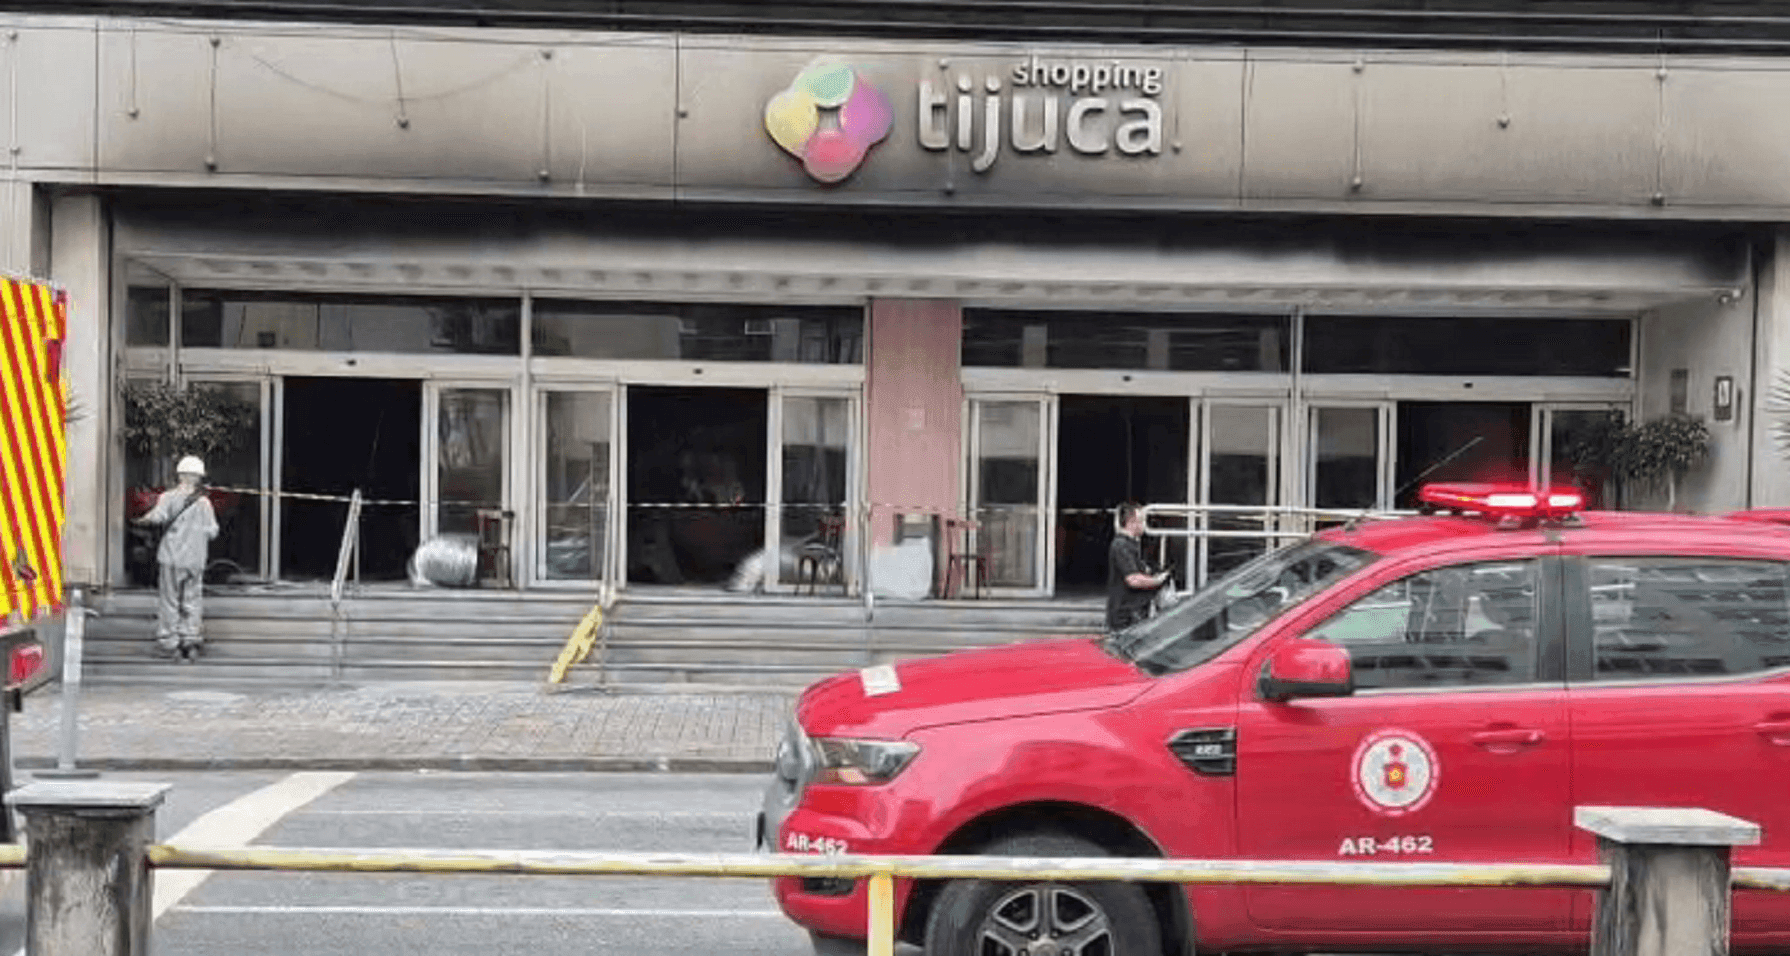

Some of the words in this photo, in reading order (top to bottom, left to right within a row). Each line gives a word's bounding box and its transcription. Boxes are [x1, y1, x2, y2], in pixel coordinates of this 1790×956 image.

[1012, 56, 1164, 94] shopping
[918, 74, 1164, 173] tijuca
[786, 831, 849, 857] AR-462
[1337, 835, 1434, 856] AR-462
